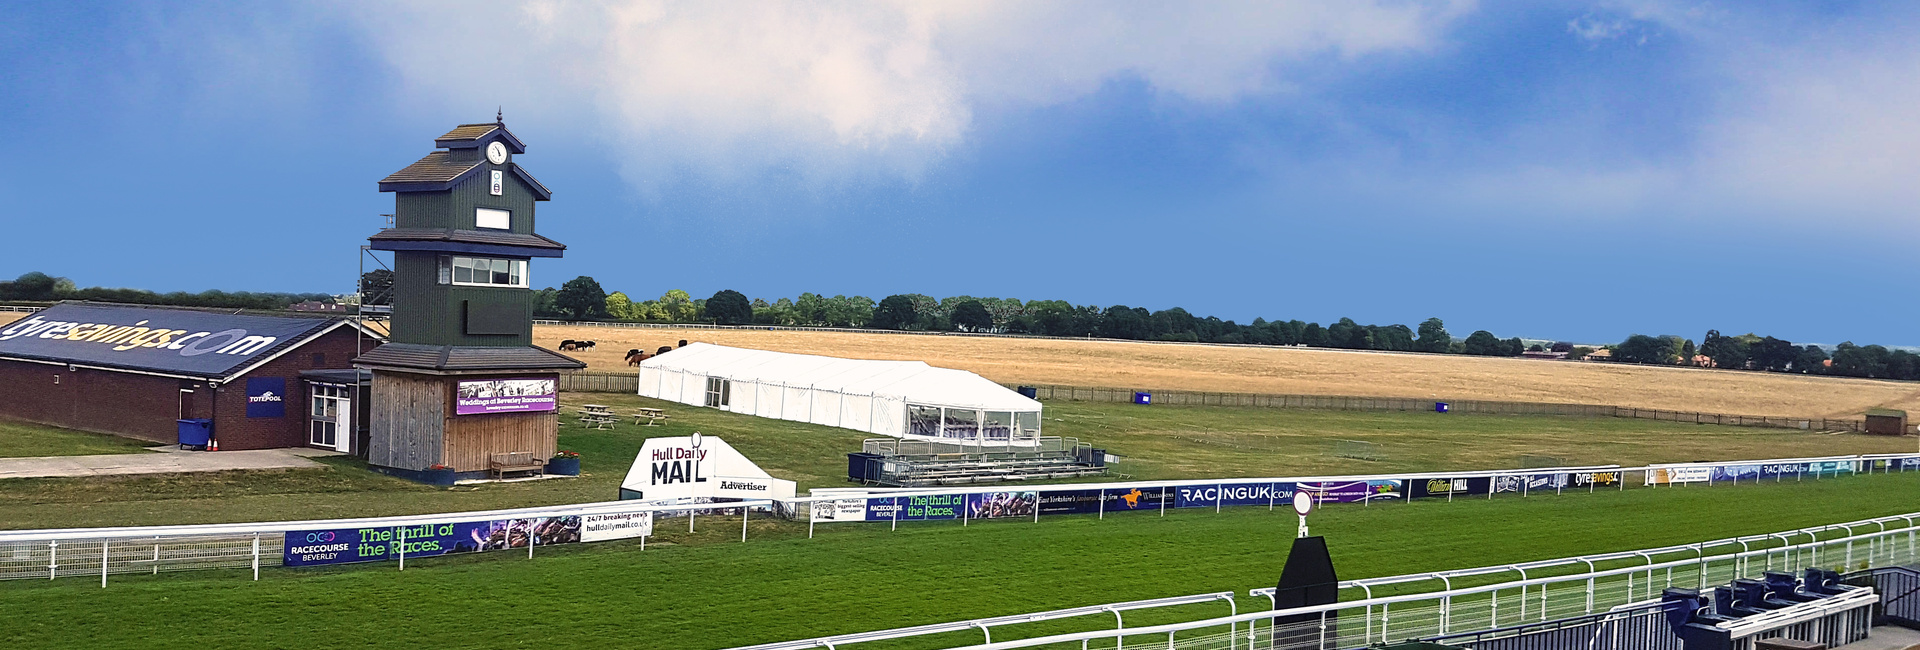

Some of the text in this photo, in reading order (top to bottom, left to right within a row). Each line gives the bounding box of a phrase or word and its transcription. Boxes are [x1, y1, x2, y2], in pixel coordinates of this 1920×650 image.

[0, 315, 277, 357] tyresavings.com
[652, 447, 707, 461] Hull Daily
[651, 460, 707, 485] MAIL
[720, 481, 767, 491] Advertiser
[1454, 479, 1467, 490] HILL
[908, 494, 963, 506] The thrill of
[1143, 492, 1174, 500] WILLIAMONS
[1181, 487, 1293, 501] RACINGUKCOM
[907, 506, 955, 516] the Races.
[358, 522, 455, 543] The thrill of
[291, 543, 349, 555] RACECOURSE
[358, 540, 443, 557] the Races.
[302, 552, 339, 562] BEVERLEY
